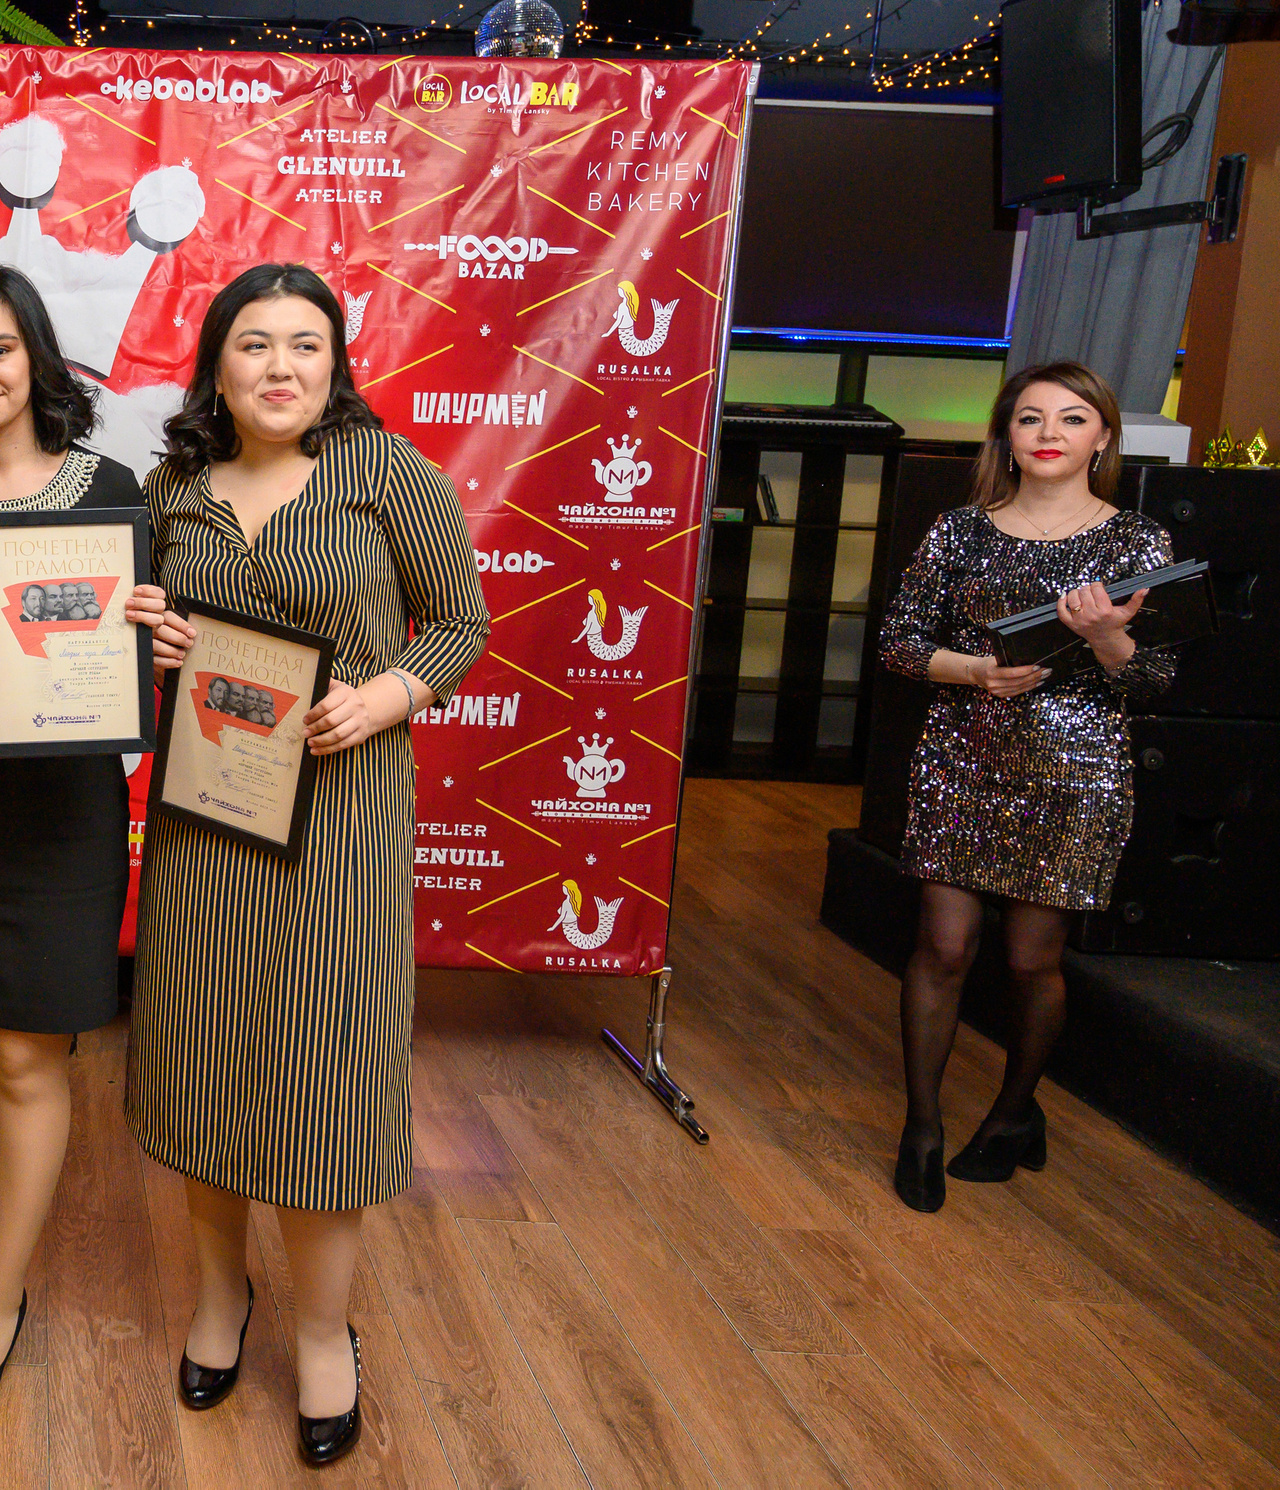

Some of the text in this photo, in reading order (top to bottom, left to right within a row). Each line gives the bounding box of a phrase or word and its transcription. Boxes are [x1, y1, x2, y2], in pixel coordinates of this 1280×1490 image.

[421, 91, 445, 102] BAR
[460, 80, 579, 106] LOCAL BAR
[299, 128, 388, 144] ATELIER
[610, 130, 688, 151] REMY
[277, 155, 406, 178] GLENUILL
[586, 161, 710, 182] KITCHEN
[295, 188, 383, 204] ATELIER
[587, 192, 703, 212] BAKERY
[458, 262, 525, 280] BAZAR
[597, 364, 672, 376] RUSALKA
[558, 502, 676, 518] ЧАЙХОНА №1
[3, 537, 118, 557] ПОЧЕТНАЯ
[15, 557, 110, 576] ГРАМОТА
[200, 630, 304, 674] ПОЧЕТНАЯ
[207, 651, 292, 689] ГРАМОТА
[567, 668, 643, 679] RUSALKA
[531, 797, 651, 814] ЧАЙХОНА №1
[414, 823, 487, 837] TELIER
[414, 847, 505, 867] ENUILL
[413, 876, 482, 891] TELIER
[545, 956, 621, 969] RUSALKA
